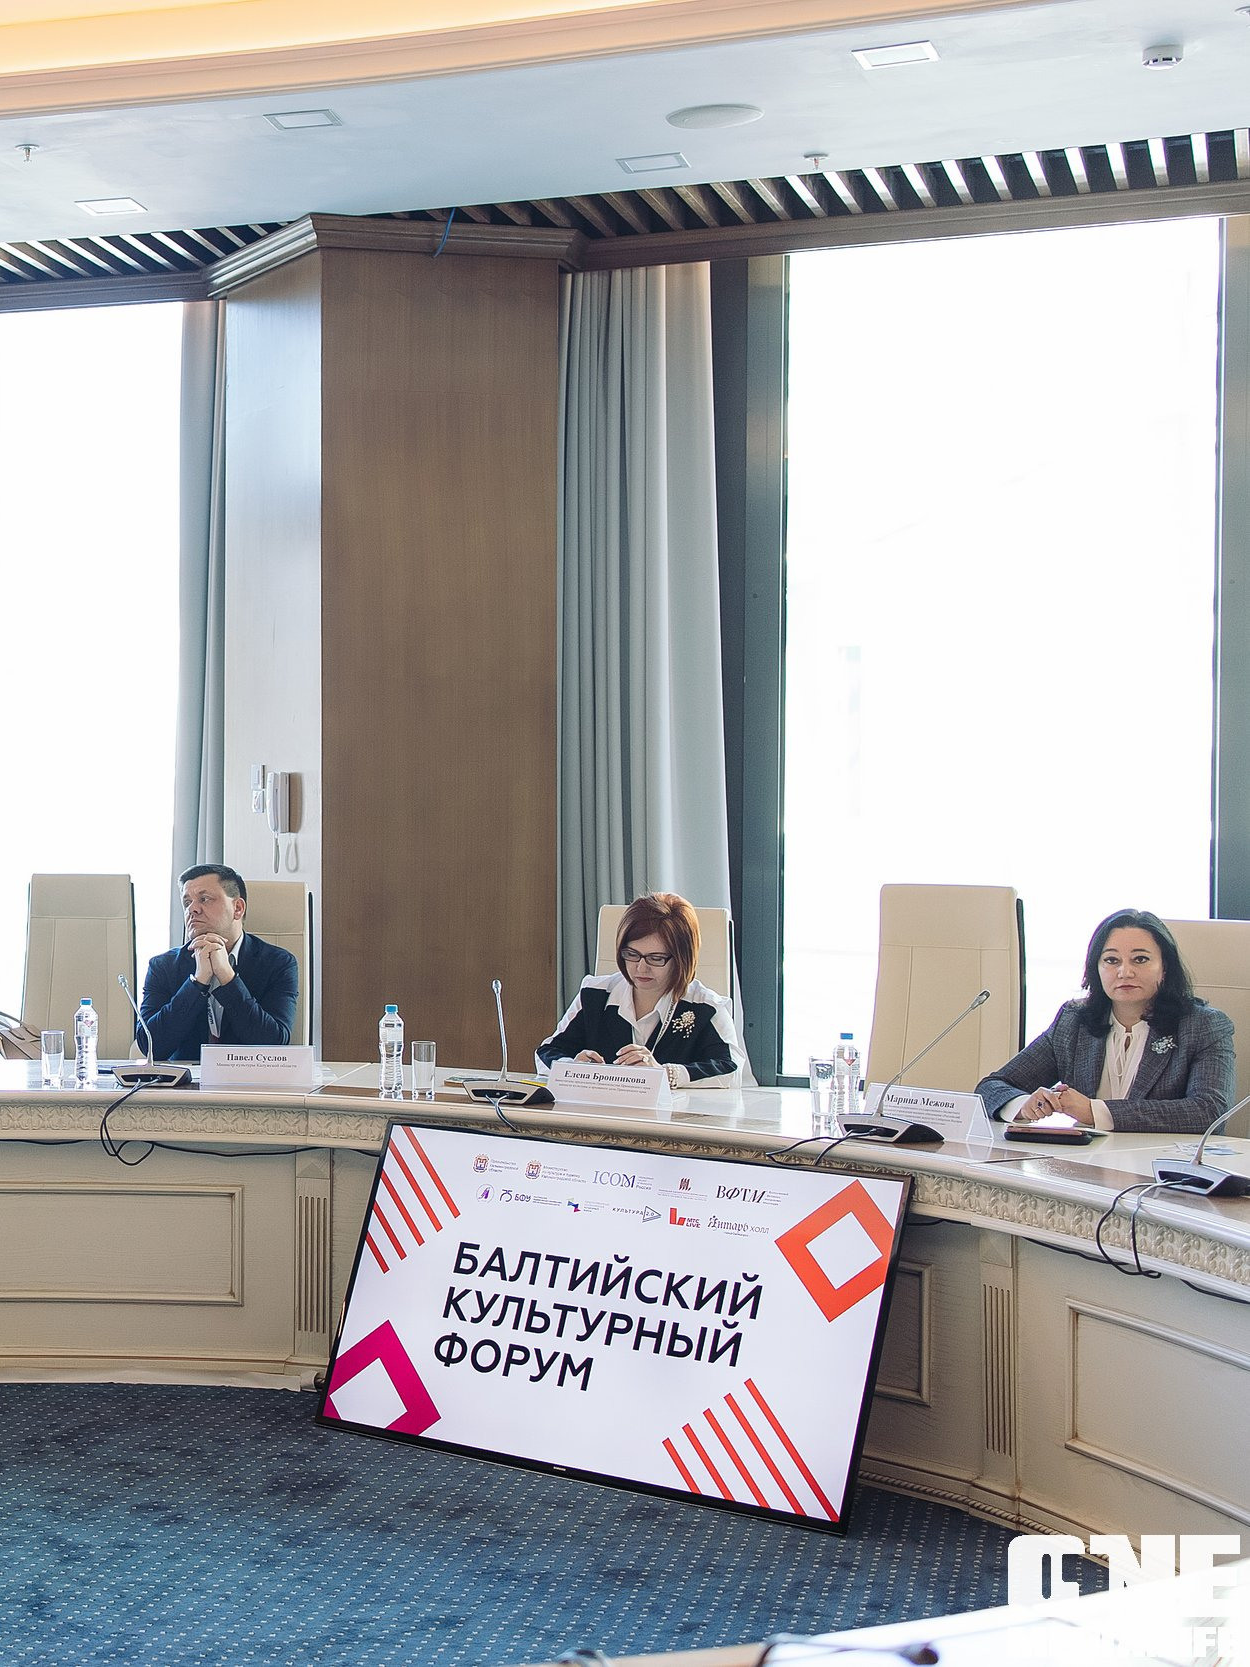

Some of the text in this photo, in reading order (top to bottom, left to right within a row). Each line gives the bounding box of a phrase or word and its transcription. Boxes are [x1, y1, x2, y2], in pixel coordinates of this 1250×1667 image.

[256, 1053, 287, 1063] Суслов
[564, 1070, 590, 1079] Елена
[593, 1073, 646, 1084] Бронникова
[885, 1094, 955, 1109] Марина Межова
[592, 1170, 636, 1189] ICOM
[499, 1189, 513, 1203] 75
[716, 1185, 766, 1204] ВФТМ
[452, 1241, 763, 1320] БАЛТИЙСКИЙ
[442, 1286, 743, 1368] КУЛЬТУРНЫЙ
[434, 1332, 594, 1392] ФОРУМ
